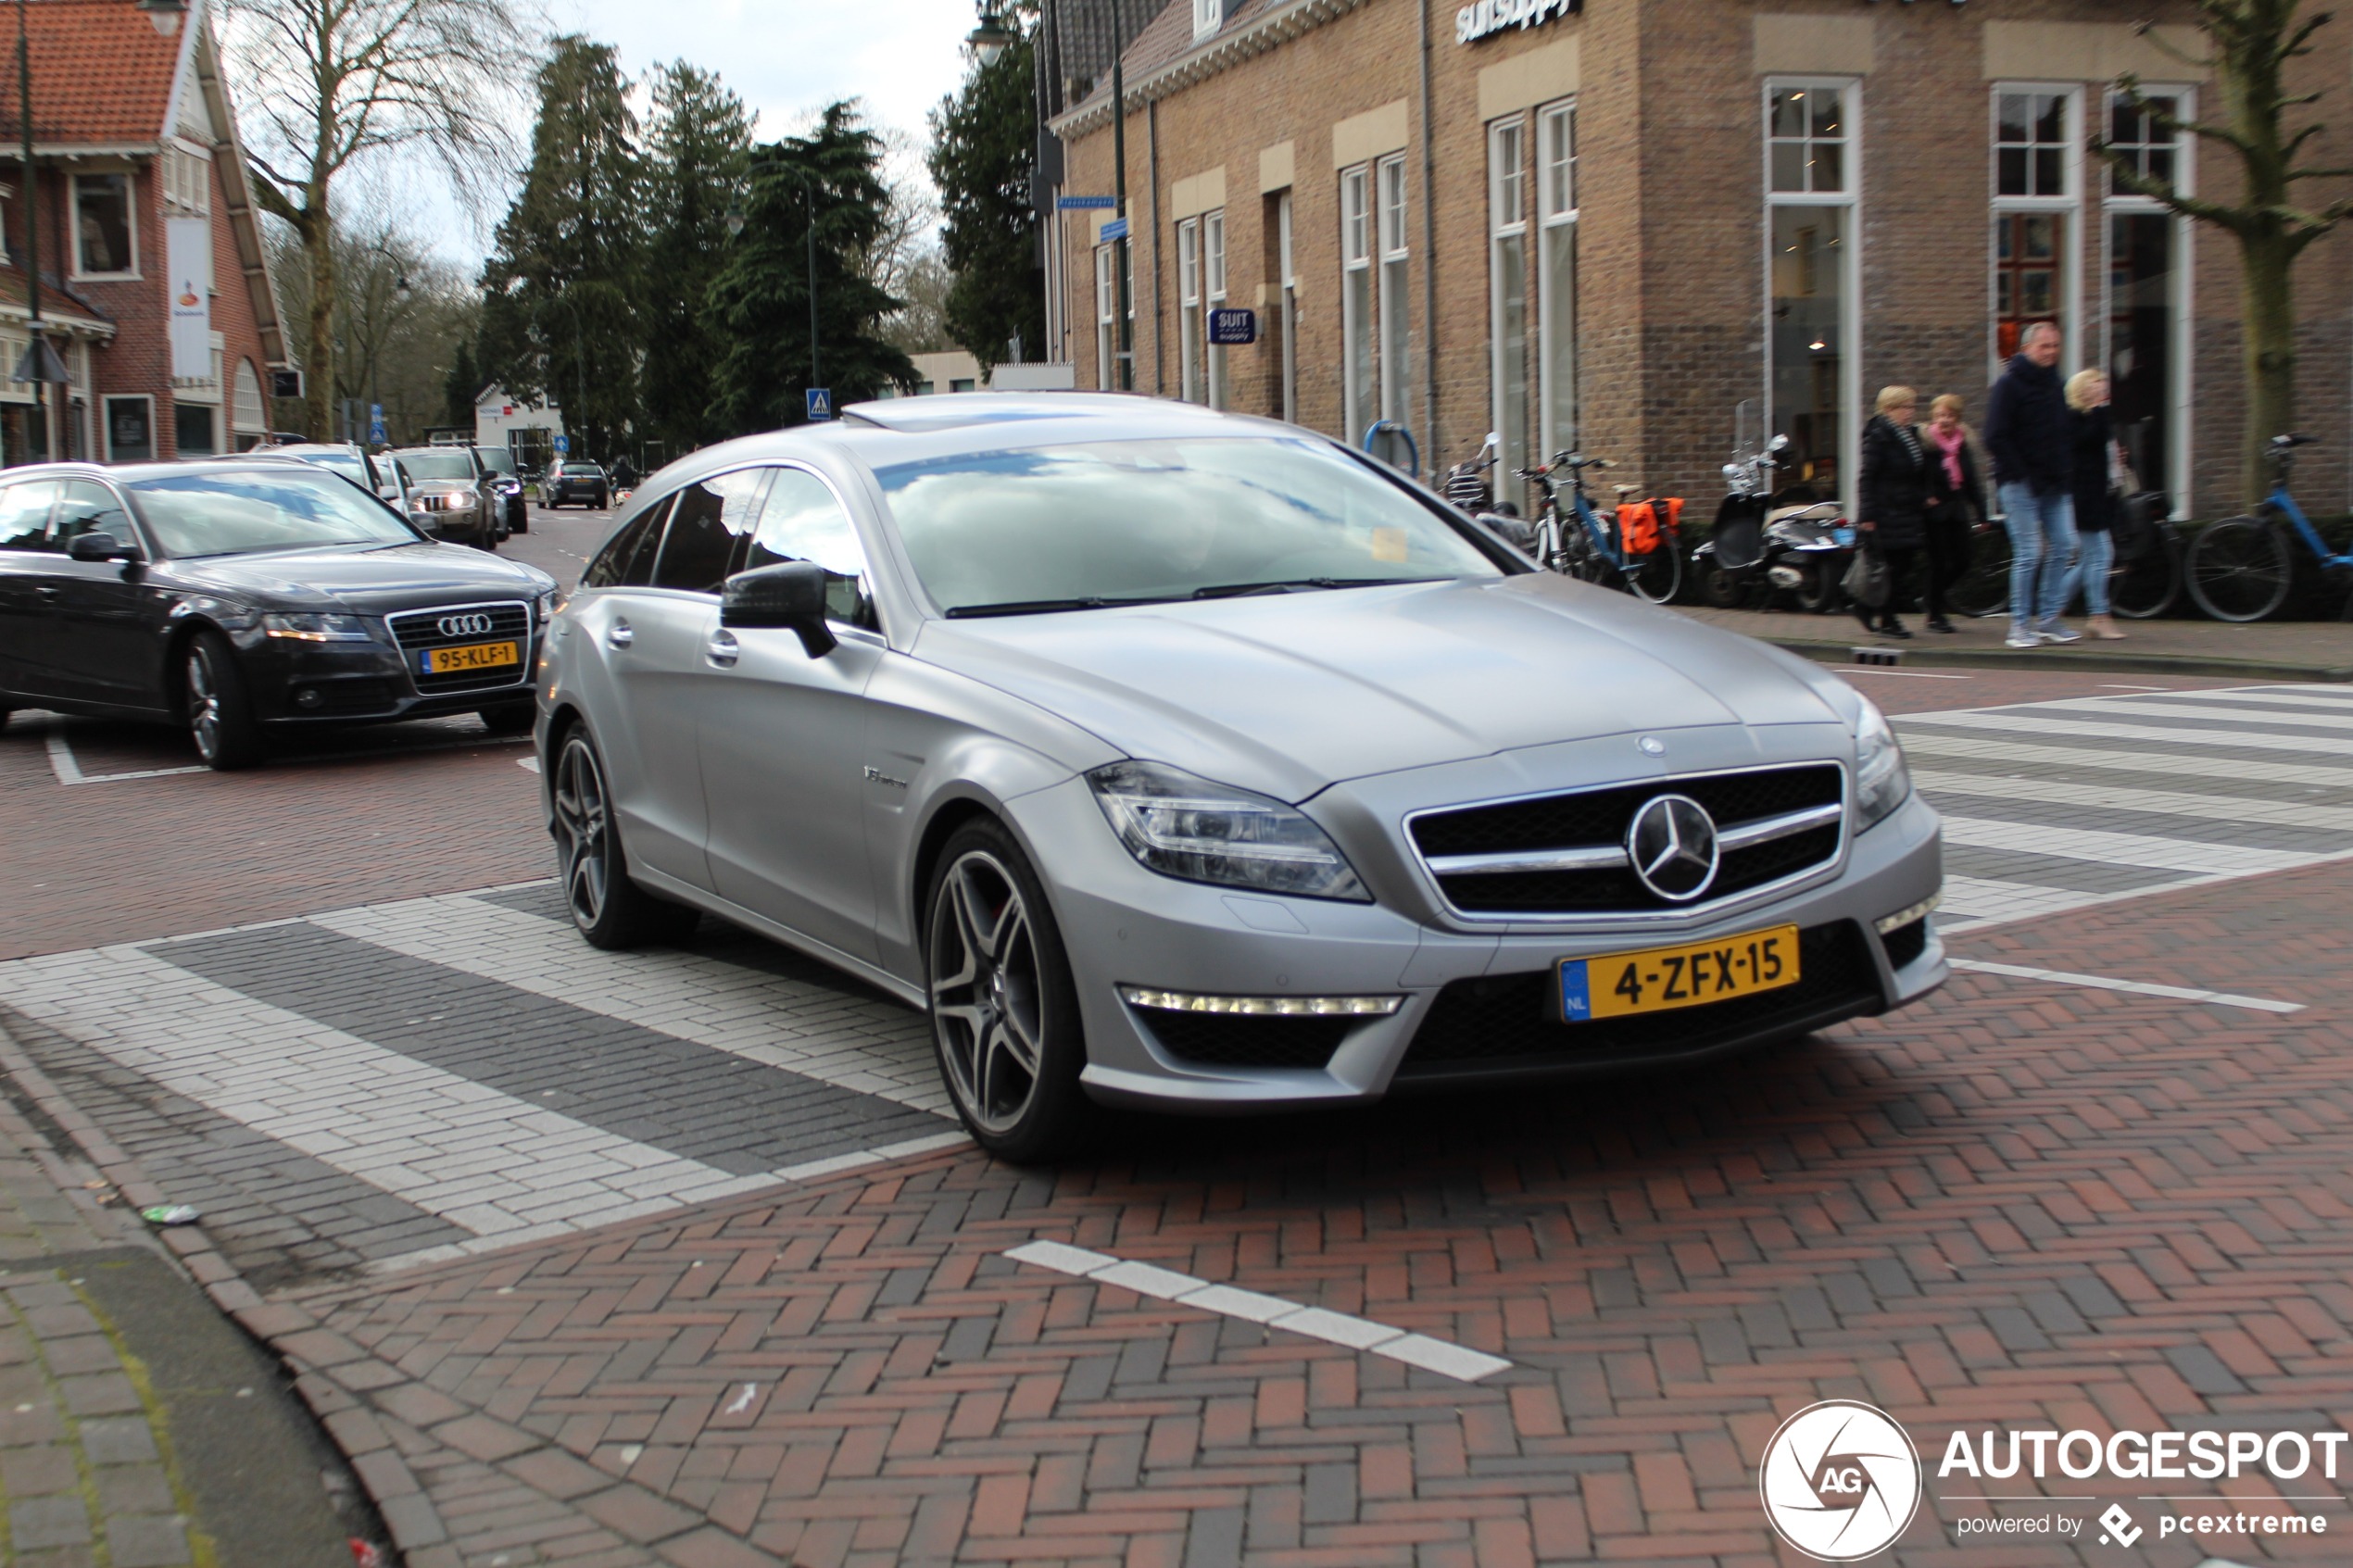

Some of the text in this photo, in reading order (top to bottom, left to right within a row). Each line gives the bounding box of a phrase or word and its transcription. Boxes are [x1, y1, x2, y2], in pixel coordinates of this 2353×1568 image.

[1218, 312, 1249, 328] SUIT
[438, 646, 510, 669] 95-KLF-1
[1615, 938, 1781, 1004] 4-ZFX-15
[1567, 997, 1586, 1010] NL
